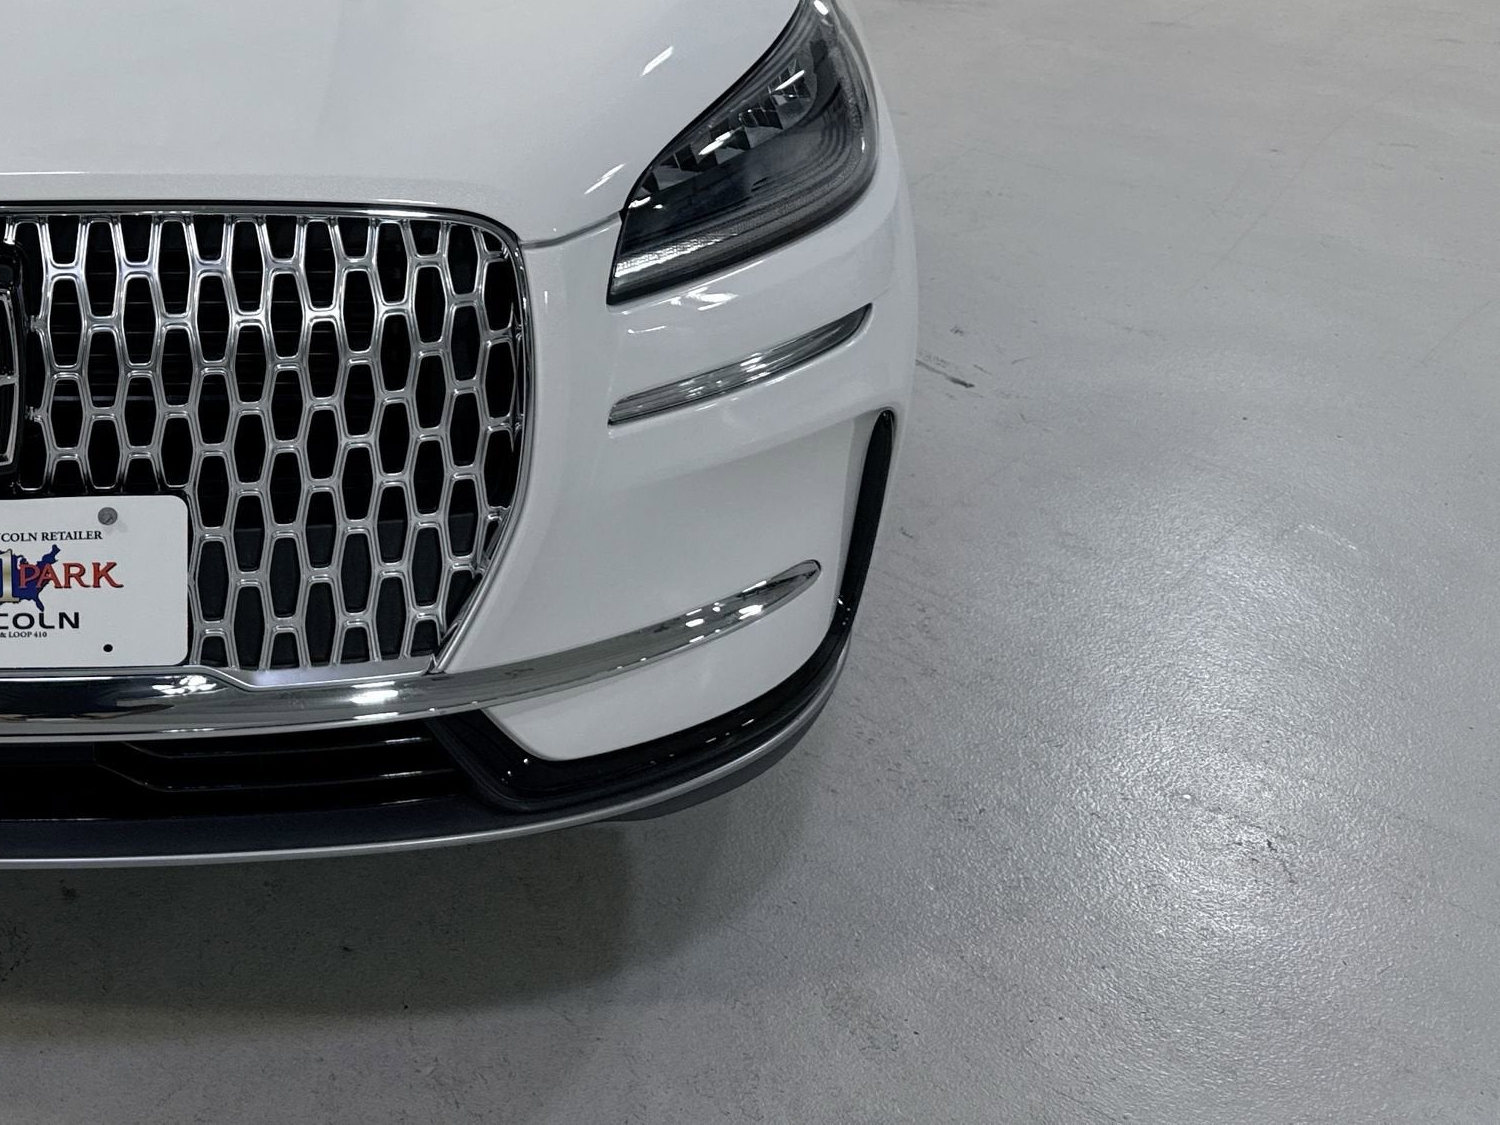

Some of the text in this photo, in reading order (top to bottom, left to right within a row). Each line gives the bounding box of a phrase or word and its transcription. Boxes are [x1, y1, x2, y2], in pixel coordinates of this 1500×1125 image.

[41, 530, 103, 541] RETAILER
[18, 561, 124, 589] PARK
[0, 631, 7, 639] &
[8, 631, 33, 639] LOOP
